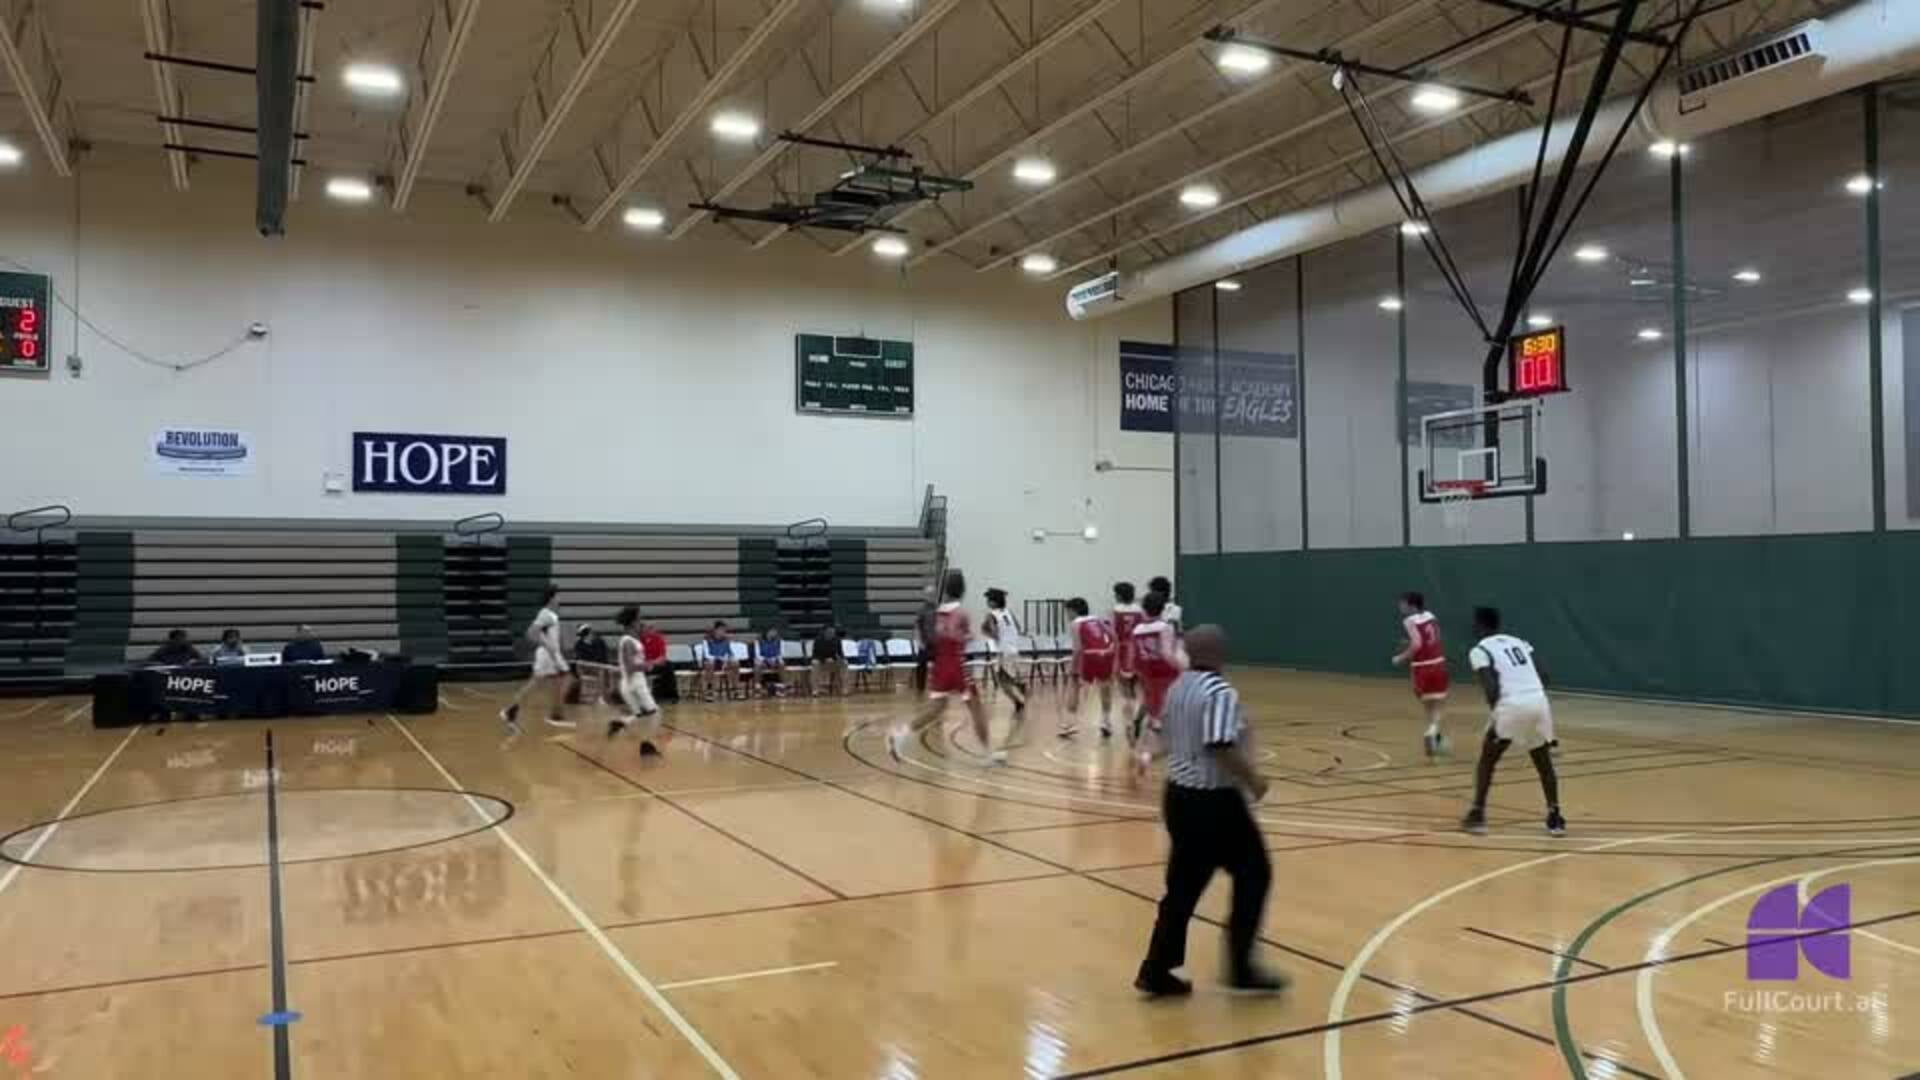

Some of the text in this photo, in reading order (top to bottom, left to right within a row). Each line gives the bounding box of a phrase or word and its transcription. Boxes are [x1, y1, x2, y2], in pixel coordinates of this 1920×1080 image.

[20, 309, 35, 331] 2
[22, 340, 35, 357] 0
[1521, 355, 1551, 389] 00
[1125, 393, 1169, 412] HOME
[165, 431, 239, 447] REVOLUTION
[362, 441, 498, 486] HOPE
[1504, 646, 1527, 667] 10
[167, 675, 214, 694] HOPE
[315, 676, 359, 693] HOPE
